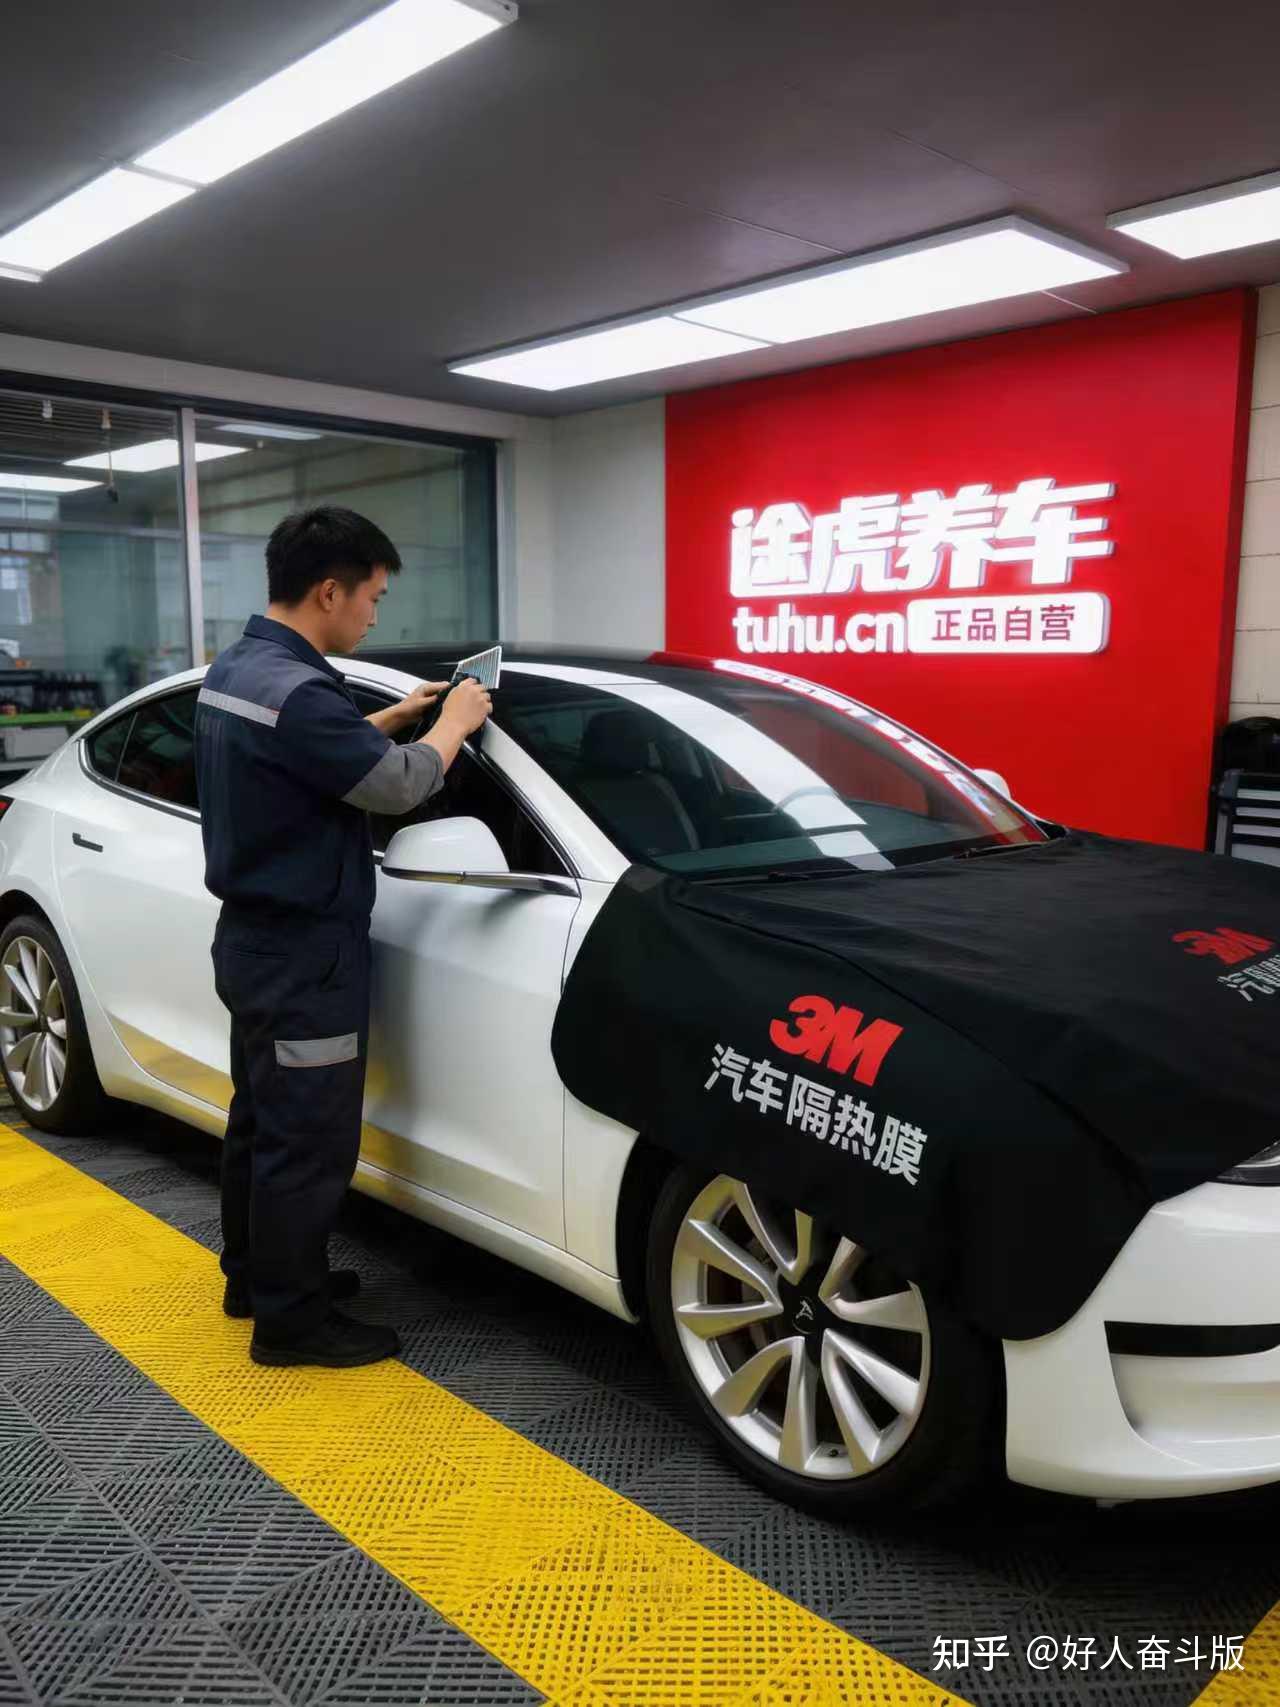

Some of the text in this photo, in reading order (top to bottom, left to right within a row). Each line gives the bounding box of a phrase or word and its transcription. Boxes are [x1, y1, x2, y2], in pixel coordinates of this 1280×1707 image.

[730, 478, 1116, 598] 途虎养车
[732, 603, 908, 654] tuhu.cn
[932, 604, 1076, 643] 正品自营
[769, 995, 904, 1087] 3M
[704, 1043, 928, 1186] 汽车隔热膜
